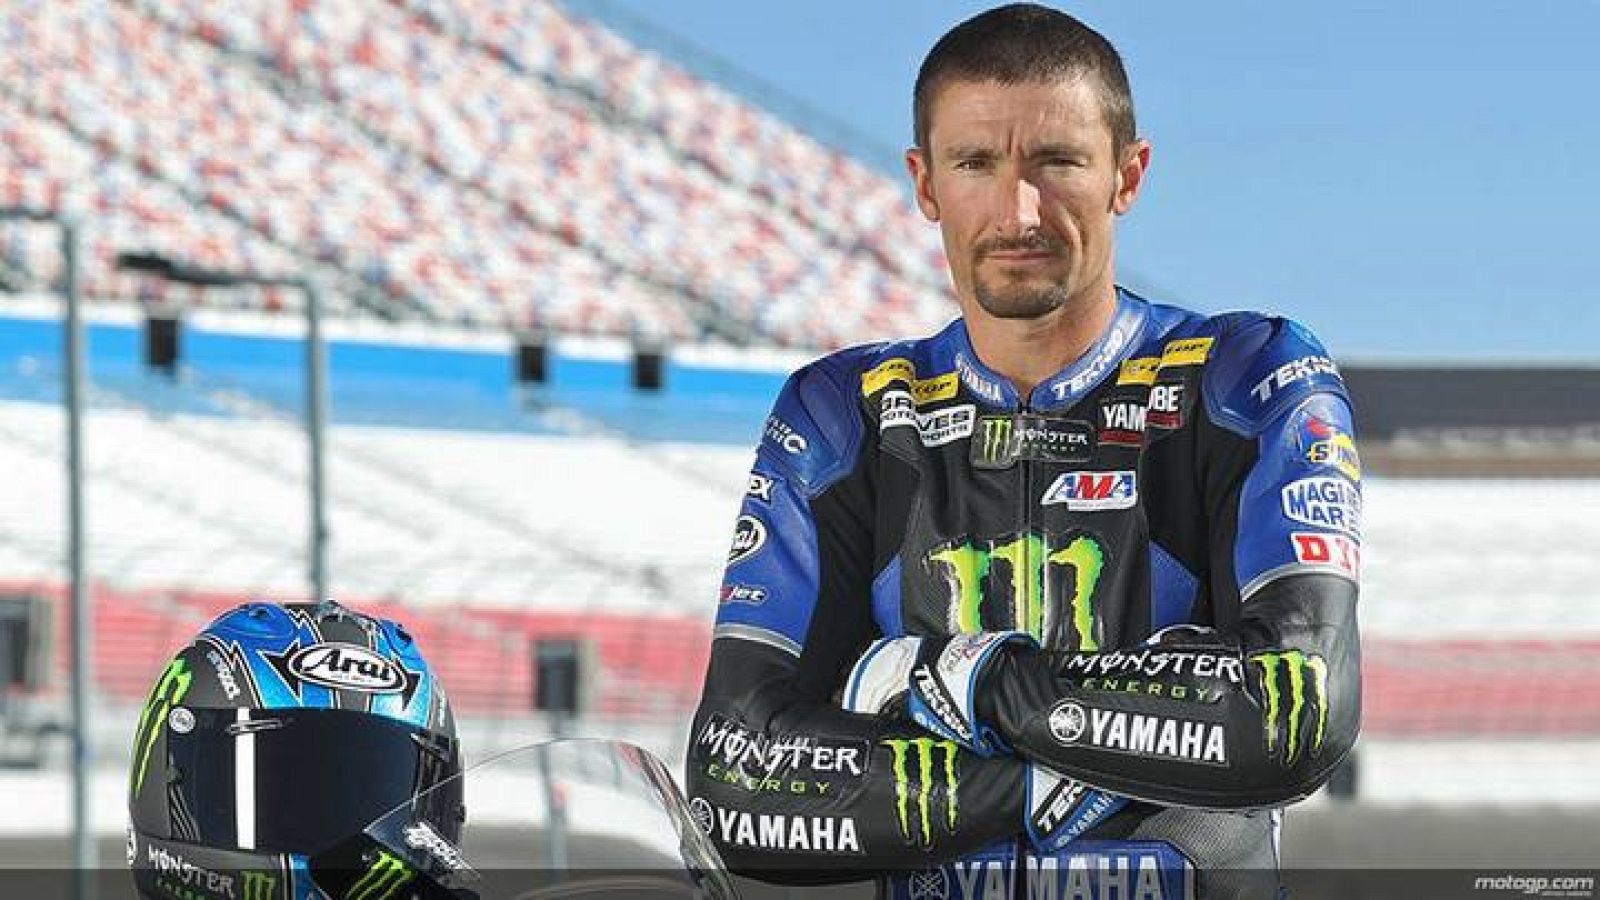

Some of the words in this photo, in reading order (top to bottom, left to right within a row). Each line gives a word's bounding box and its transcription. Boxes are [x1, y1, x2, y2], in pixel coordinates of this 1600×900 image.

[1050, 474, 1134, 499] AMA
[303, 649, 394, 682] Arai
[1066, 650, 1243, 682] MONSTER
[1081, 677, 1210, 701] ENERGY
[700, 720, 861, 780] MONSTER
[1090, 708, 1226, 762] YAMAHA
[707, 763, 831, 795] ENERGY
[718, 807, 859, 852] YAMAHA
[148, 843, 236, 899] MONSTER
[954, 855, 1163, 900] YAMAHA
